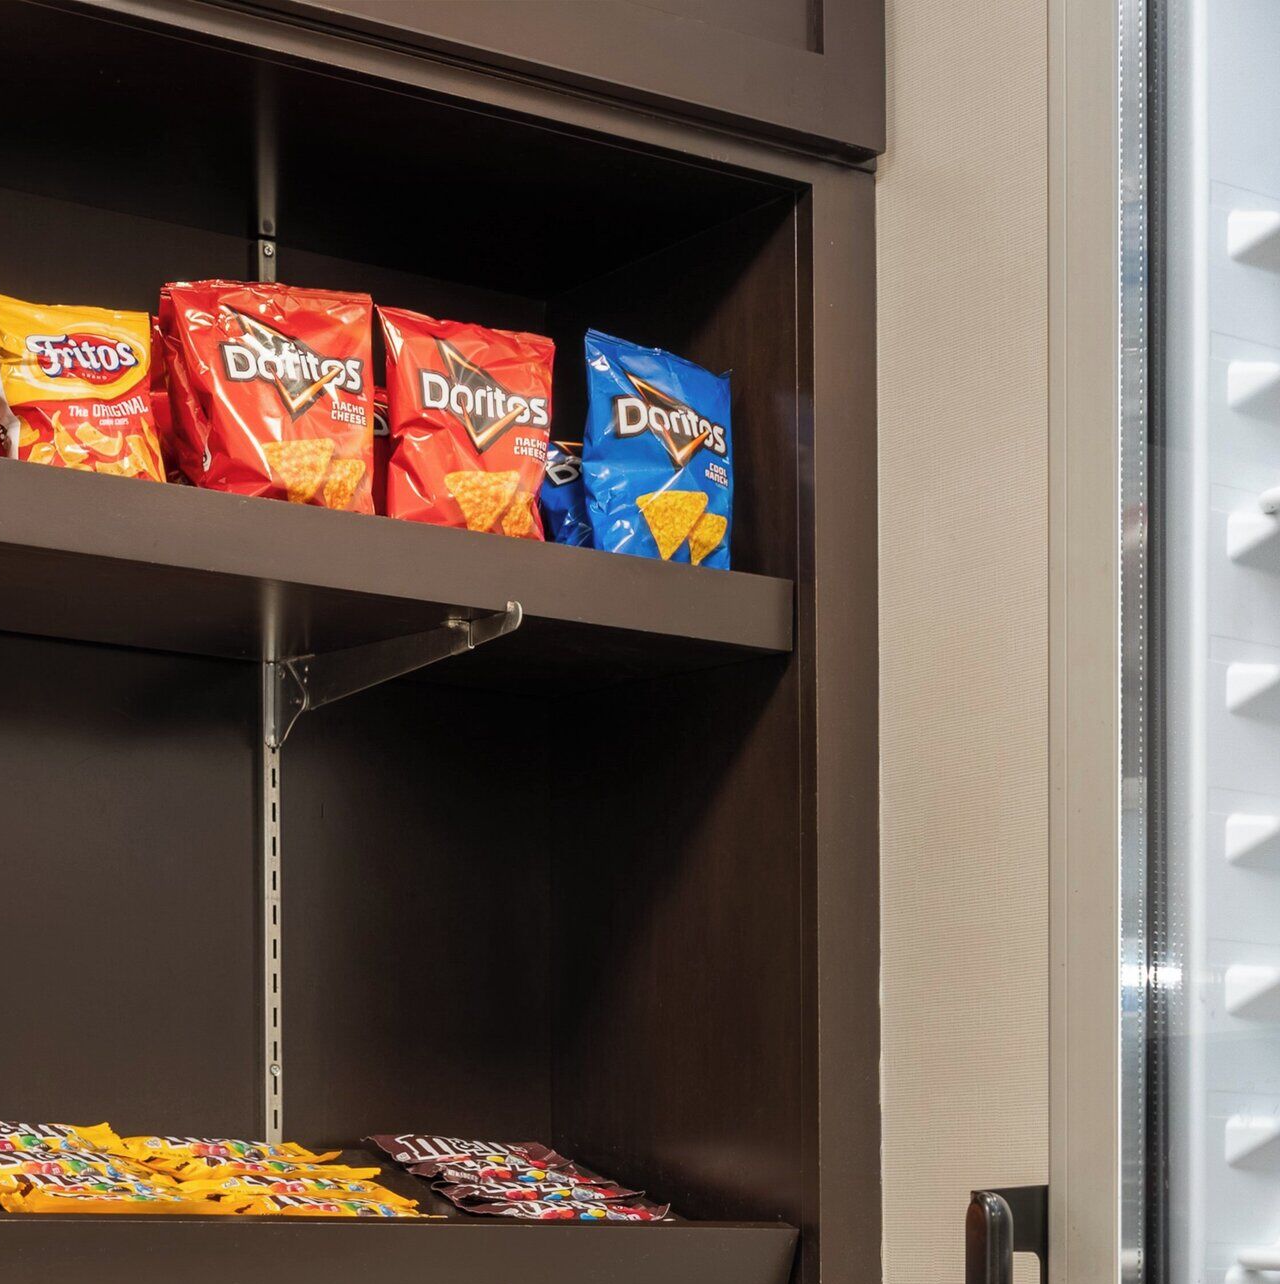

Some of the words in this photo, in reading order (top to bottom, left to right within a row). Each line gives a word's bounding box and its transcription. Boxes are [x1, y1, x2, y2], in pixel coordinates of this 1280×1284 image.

[25, 333, 139, 379] Fritos
[81, 372, 108, 381] BRAND
[222, 342, 364, 394] Doritos
[68, 404, 90, 418] The
[92, 395, 149, 418] ORIGINAL
[422, 371, 550, 428] Doritos
[332, 401, 366, 416] NACHO
[331, 410, 368, 427] CHEESE
[617, 396, 728, 456] Doritos
[515, 436, 548, 452] NACHO
[513, 445, 548, 461] CHEESE
[708, 462, 728, 478] COOL
[704, 470, 730, 488] RANCH
